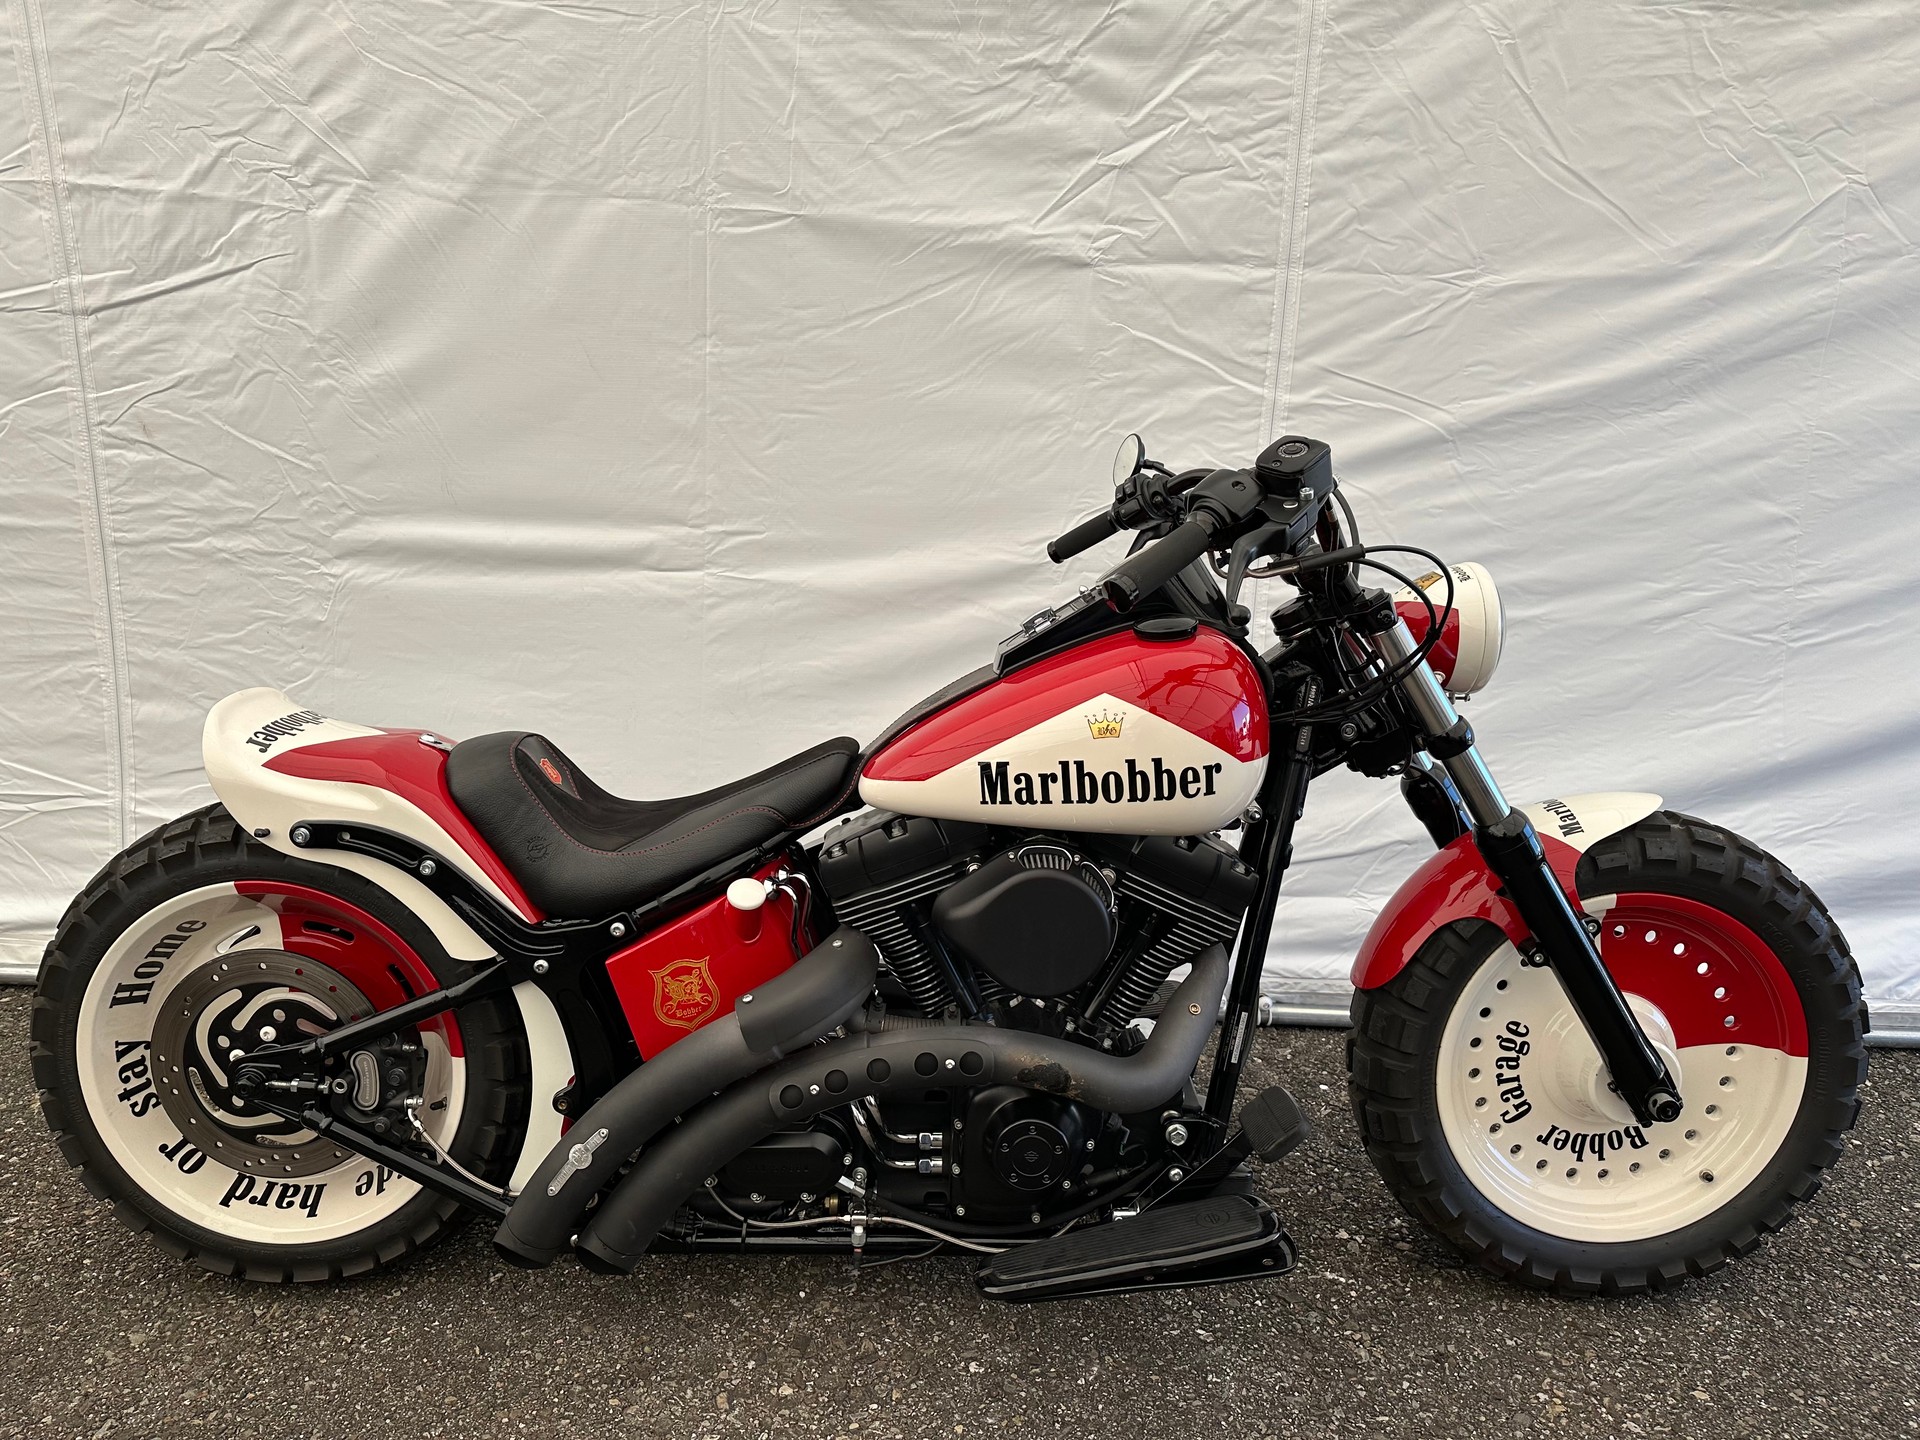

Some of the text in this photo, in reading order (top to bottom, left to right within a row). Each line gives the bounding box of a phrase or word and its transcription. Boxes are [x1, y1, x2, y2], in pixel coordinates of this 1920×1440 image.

[977, 757, 1222, 805] Marlbobber
[109, 919, 207, 1009] Home
[115, 1039, 161, 1118] stay
[1495, 1020, 1532, 1124] Garage
[158, 1133, 208, 1175] or
[1536, 1124, 1649, 1163] Bobber
[219, 1172, 327, 1219] hard
